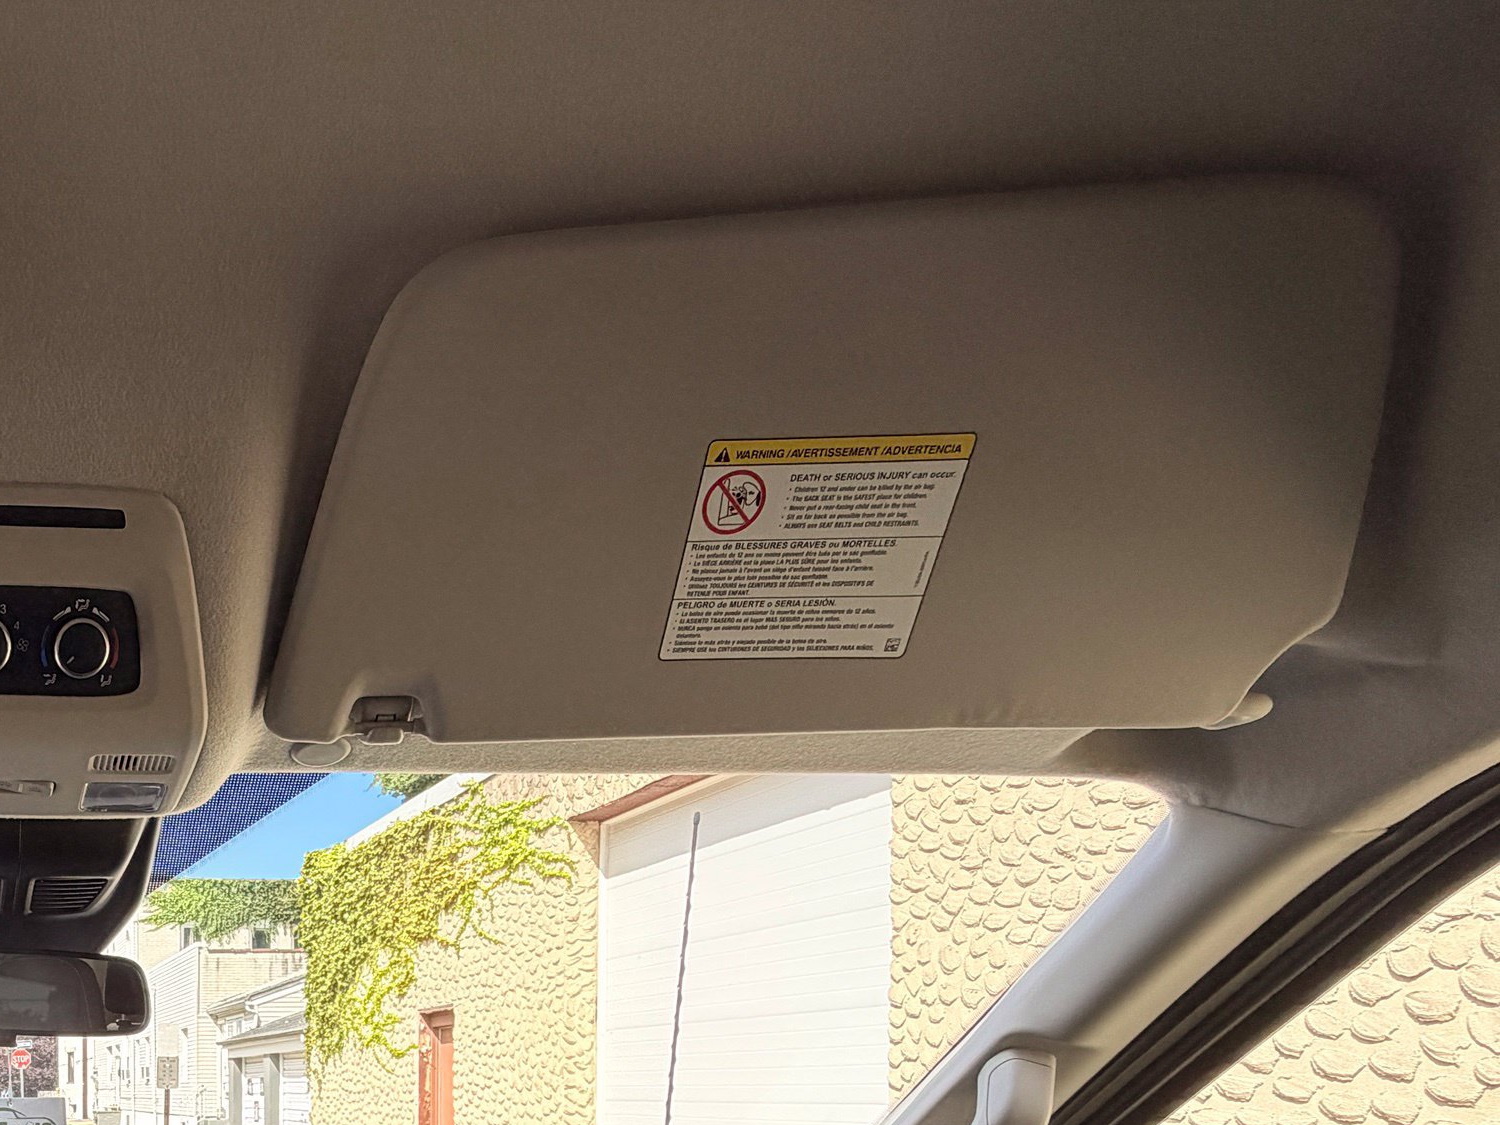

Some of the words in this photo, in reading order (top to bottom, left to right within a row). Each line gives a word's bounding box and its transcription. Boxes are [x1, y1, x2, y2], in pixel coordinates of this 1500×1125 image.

[735, 448, 785, 459] WARNING
[790, 473, 821, 482] DEATH
[834, 472, 875, 481] SERIOUS
[877, 471, 912, 480] INJURY
[691, 543, 720, 552] Risque
[734, 541, 789, 550] BLESSURES
[789, 541, 827, 549] GRAVES
[0, 604, 7, 614] 3
[677, 601, 716, 609] PELIGRO
[729, 600, 766, 608] MUERTE
[774, 599, 801, 607] SERIA
[14, 621, 20, 630] 4
[11, 1055, 30, 1064] STOP
